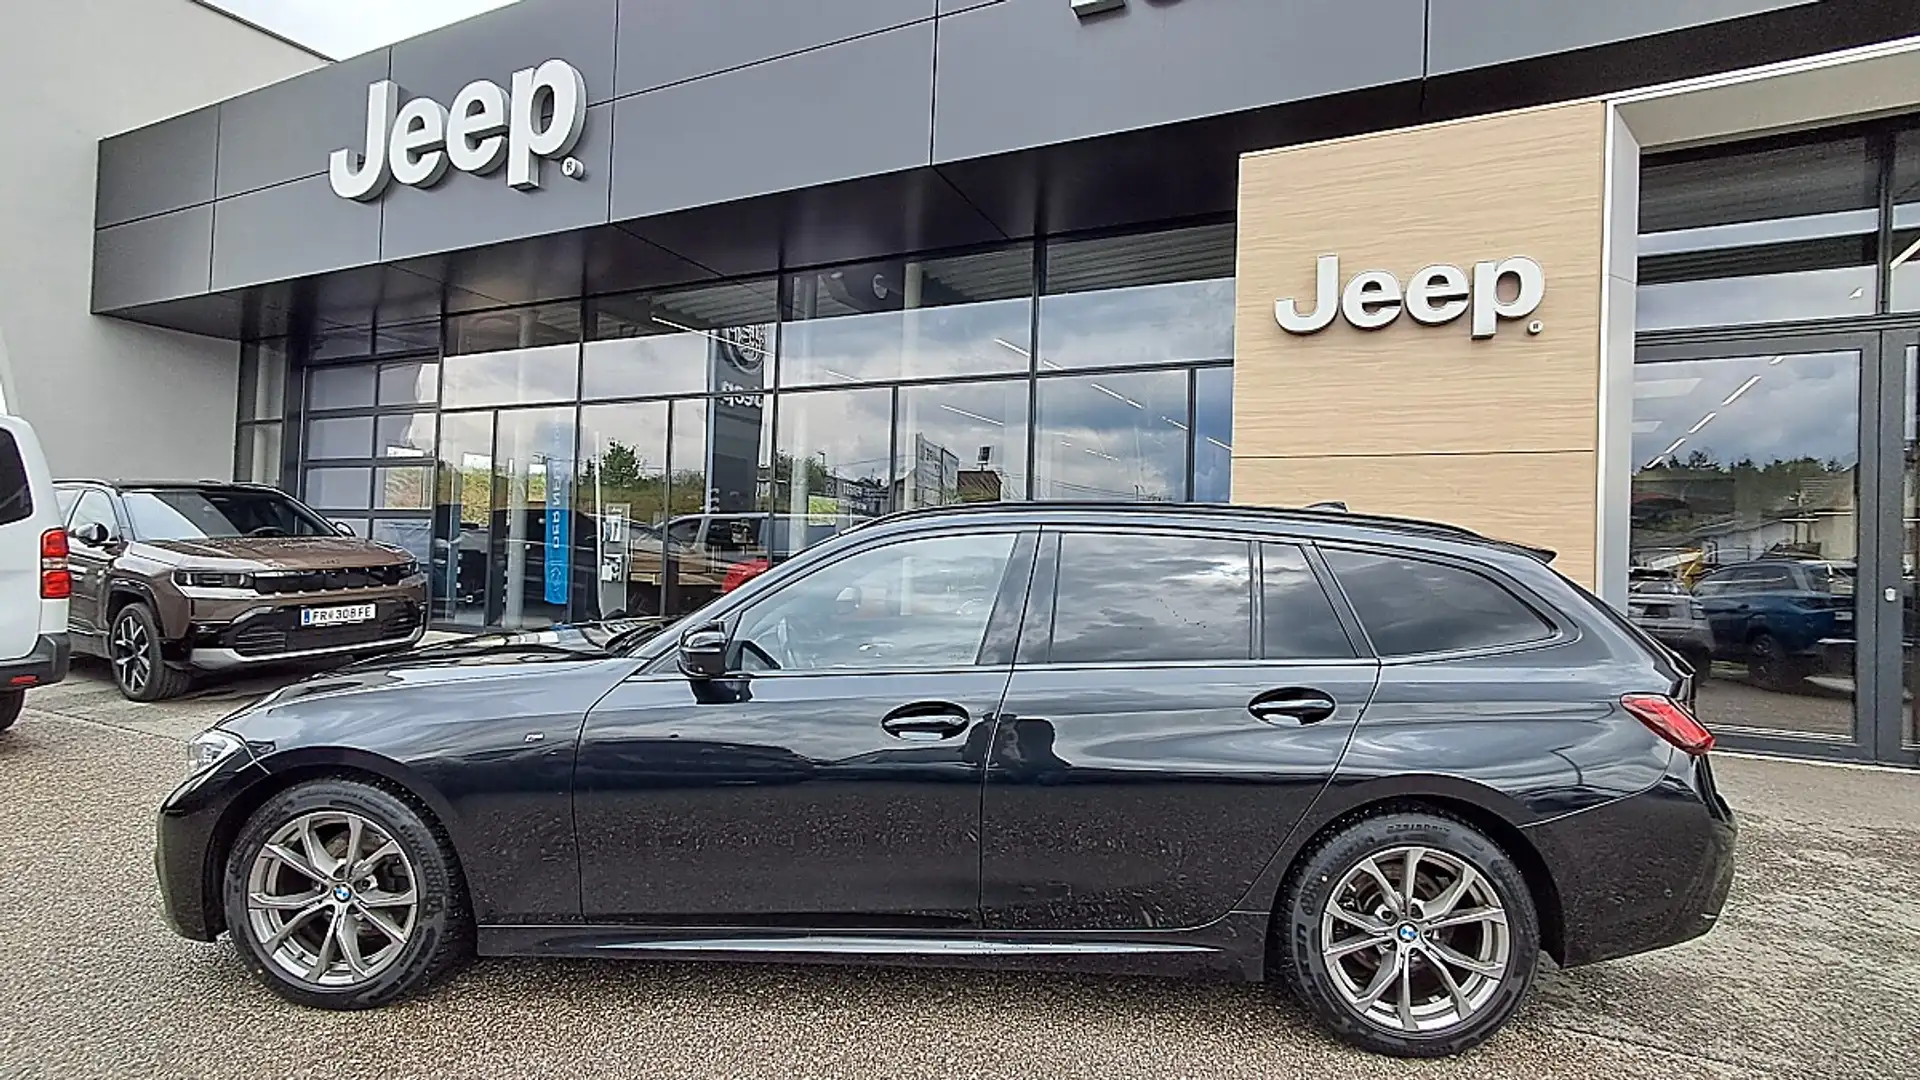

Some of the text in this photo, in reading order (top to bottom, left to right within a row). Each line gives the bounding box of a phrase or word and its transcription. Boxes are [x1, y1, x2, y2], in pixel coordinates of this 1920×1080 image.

[329, 58, 587, 202] Jeep
[1274, 252, 1545, 339] Jeep
[312, 611, 327, 621] FR
